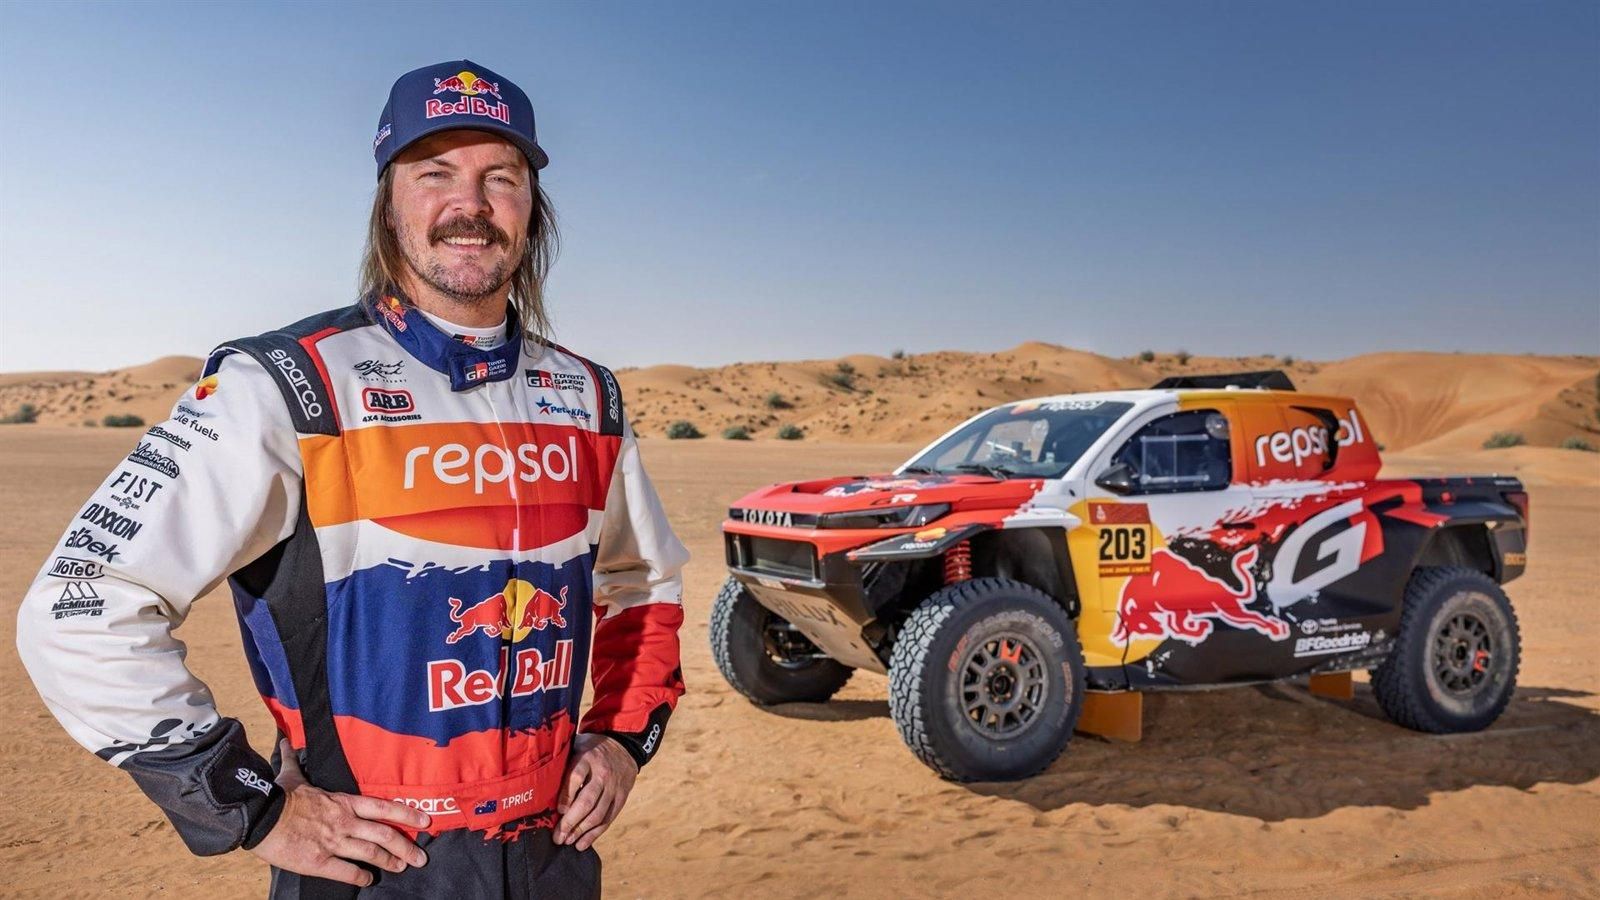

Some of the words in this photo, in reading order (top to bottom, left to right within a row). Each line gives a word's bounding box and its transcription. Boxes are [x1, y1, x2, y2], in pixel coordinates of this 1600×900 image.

[426, 96, 470, 119] Red
[470, 97, 510, 125] Bull
[265, 349, 323, 420] sparco
[466, 369, 487, 381] GR
[527, 376, 553, 388] GR
[552, 372, 586, 380] TOYOTA
[554, 378, 584, 386] GAZOO
[369, 391, 410, 410] ARB
[380, 413, 422, 422] ACCESSORIES
[189, 419, 220, 441] fuels
[1256, 409, 1364, 467] repsol
[403, 436, 578, 500] repsol
[110, 470, 163, 503] FIST
[80, 503, 143, 541] DIXXON
[742, 508, 793, 528] TOYOTA
[1099, 528, 1146, 561] 203
[1294, 631, 1371, 656] BFGoodrich
[427, 646, 509, 712] Red
[511, 639, 573, 697] Bull
[502, 789, 534, 810] T.PRICE
